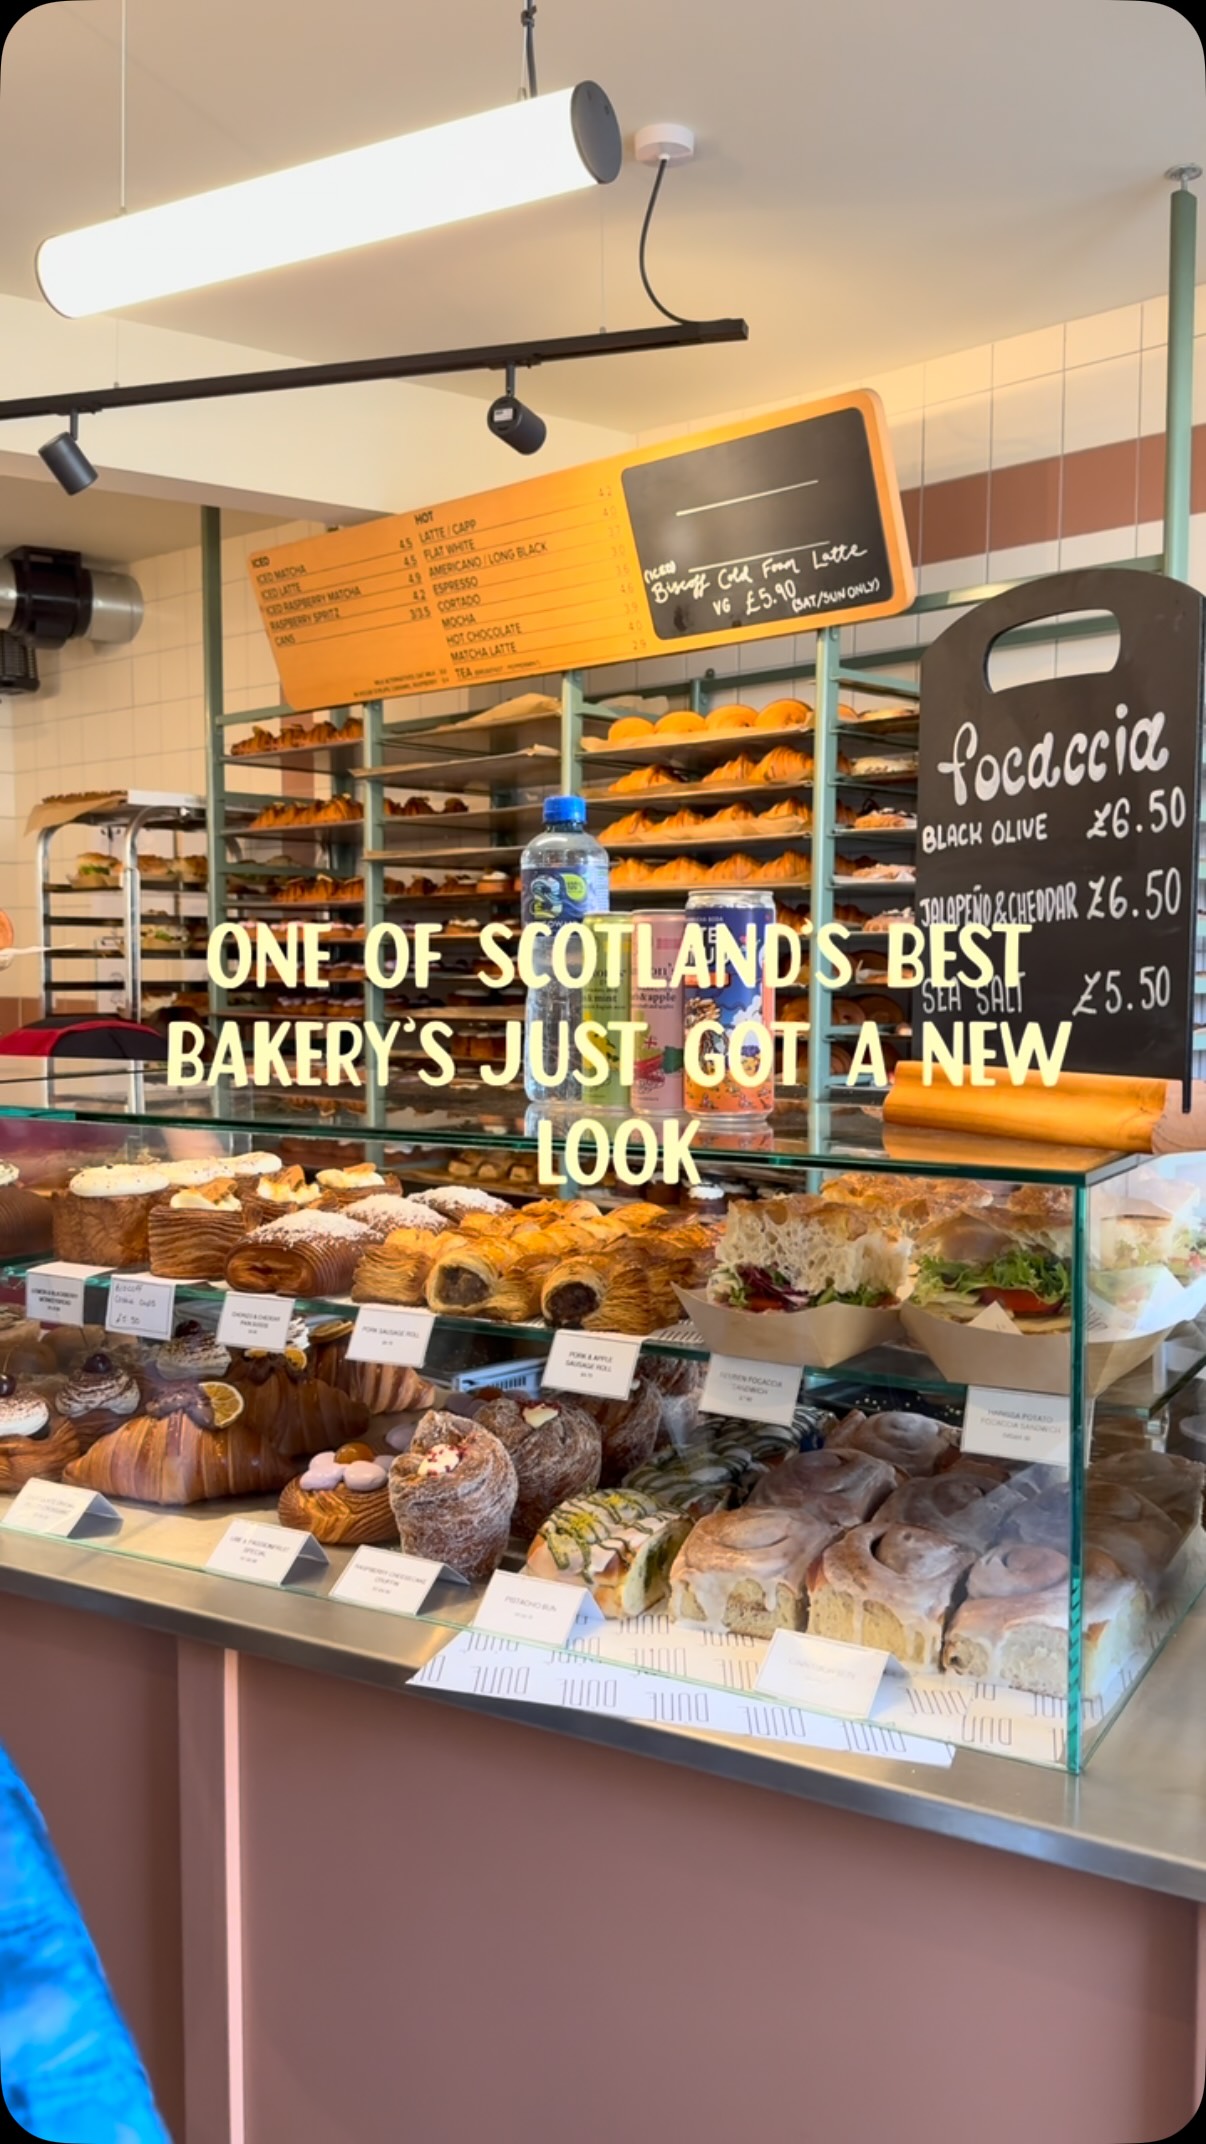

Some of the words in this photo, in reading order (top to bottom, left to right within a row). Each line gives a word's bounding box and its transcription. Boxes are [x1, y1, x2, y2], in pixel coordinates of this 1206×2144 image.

[414, 510, 434, 526] HOT
[419, 526, 446, 544] LATTE
[451, 518, 477, 536] CAPP
[423, 547, 443, 562] FLAT
[445, 538, 476, 557] WHITE
[428, 556, 482, 579] AMERICANO
[487, 548, 515, 566] LONG
[516, 541, 549, 559] BLACK
[251, 555, 271, 569] ICED
[256, 571, 274, 585] ICED
[274, 564, 307, 580] MATCHA
[651, 572, 711, 605] Biscoff
[717, 567, 753, 590] Cold
[811, 543, 868, 570] Latte
[261, 587, 279, 601] ICED
[279, 582, 302, 597] LATTE
[432, 575, 479, 596] ESPRESSO
[266, 603, 284, 617] ICED
[284, 594, 326, 612] RASPBERRY
[327, 586, 362, 602] MATCHA
[437, 593, 482, 614] CORTADO
[712, 597, 732, 616] VG
[745, 579, 797, 616] £5.90
[270, 613, 312, 631] RASPBERRY
[313, 607, 340, 624] SPRITZ
[441, 613, 477, 630] MOCHA
[274, 634, 296, 648] CANS
[446, 631, 466, 646] HOT
[466, 622, 522, 643] CHOCOLATE
[450, 645, 488, 663] MATCHA
[489, 641, 517, 658] LATTE
[454, 667, 473, 680] TEA
[937, 702, 1169, 806] focaccia
[921, 821, 983, 854] BLACK
[991, 812, 1048, 846] OLIVE
[1086, 785, 1187, 840] £6.50
[1086, 866, 1182, 921] £6.50
[920, 977, 962, 1014] SEA
[975, 971, 1027, 1015] SALT
[1071, 965, 1171, 1017] £5.50
[378, 1327, 405, 1338] SAUSAGE
[565, 1358, 595, 1371] SAUSAGE
[569, 1350, 587, 1360] PORK
[592, 1353, 614, 1364] APPLE
[748, 1375, 784, 1388] FOCACCIA
[1021, 1413, 1054, 1424] POTATO
